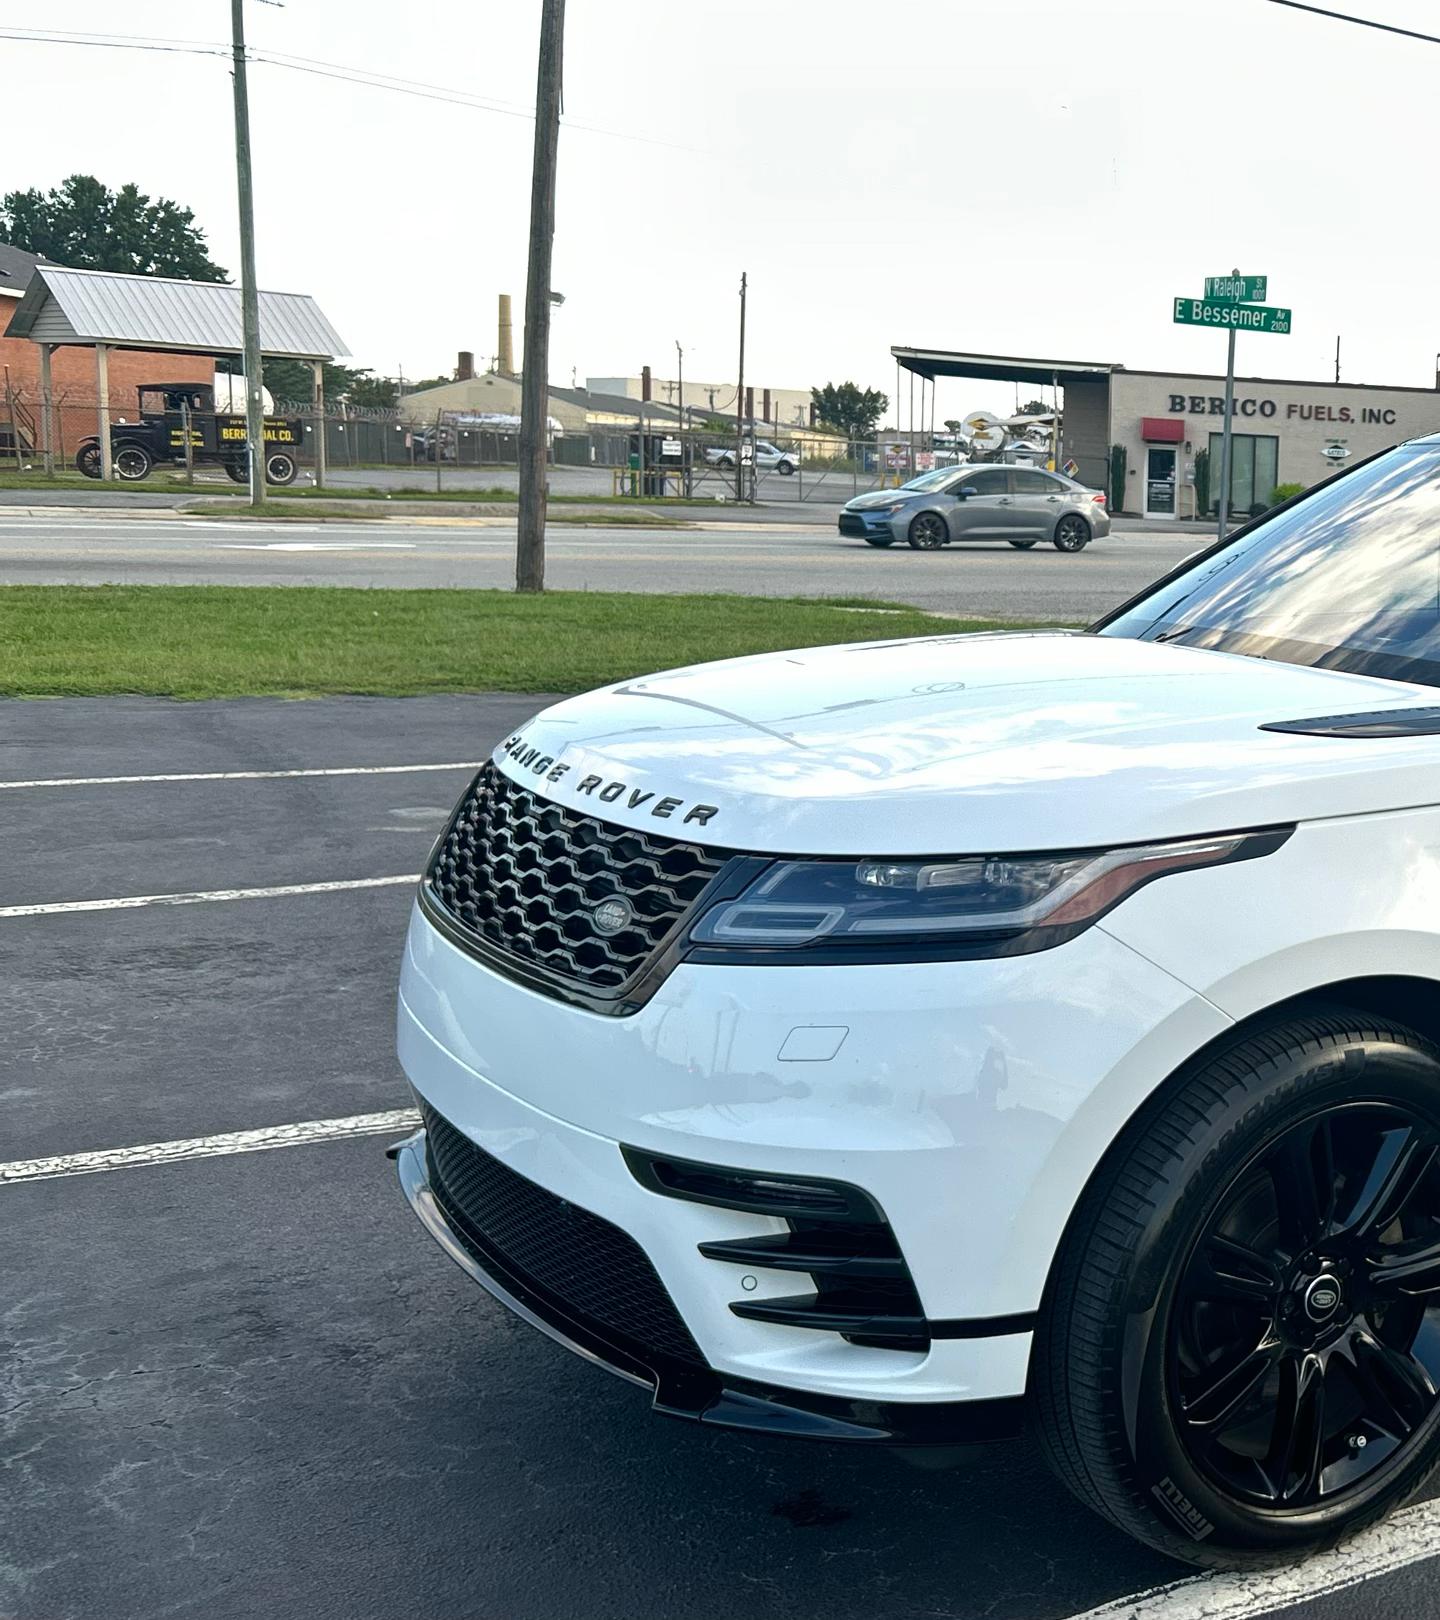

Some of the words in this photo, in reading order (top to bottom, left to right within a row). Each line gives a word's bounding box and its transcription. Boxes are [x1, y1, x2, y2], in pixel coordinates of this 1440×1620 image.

[1205, 278, 1211, 296] N
[1213, 278, 1246, 303] Raleigh
[1255, 279, 1263, 289] St
[1175, 299, 1186, 319] E
[1192, 301, 1268, 327] Bessemer
[1275, 310, 1286, 320] Av
[1271, 320, 1289, 332] 2100
[1168, 394, 1277, 418] BERICO
[1286, 404, 1355, 424] FUELS,
[1361, 408, 1397, 425] INC
[576, 774, 719, 827] ROVER
[1151, 1476, 1216, 1542] PIRELLI
